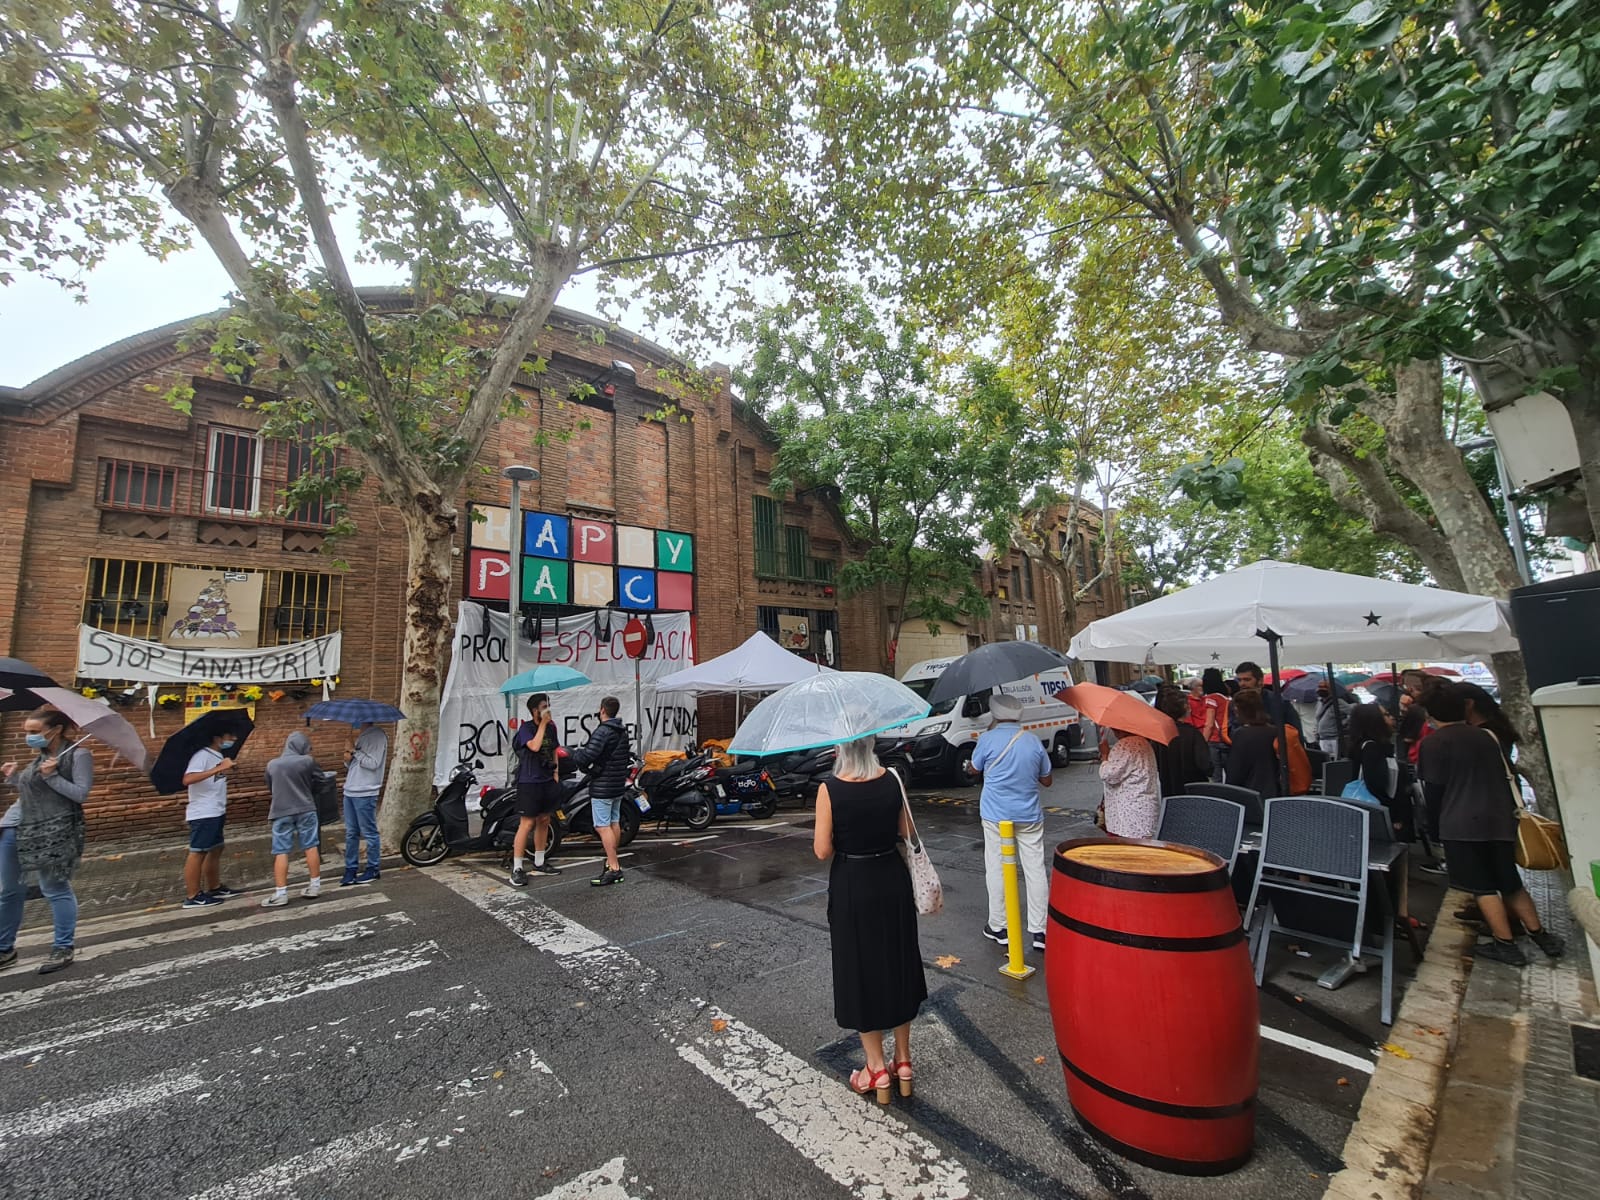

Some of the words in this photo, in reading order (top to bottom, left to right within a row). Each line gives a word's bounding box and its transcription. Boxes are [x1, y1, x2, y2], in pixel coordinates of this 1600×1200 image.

[485, 510, 683, 564] HAPPY
[477, 557, 651, 604] PARC
[84, 631, 165, 671] STOP
